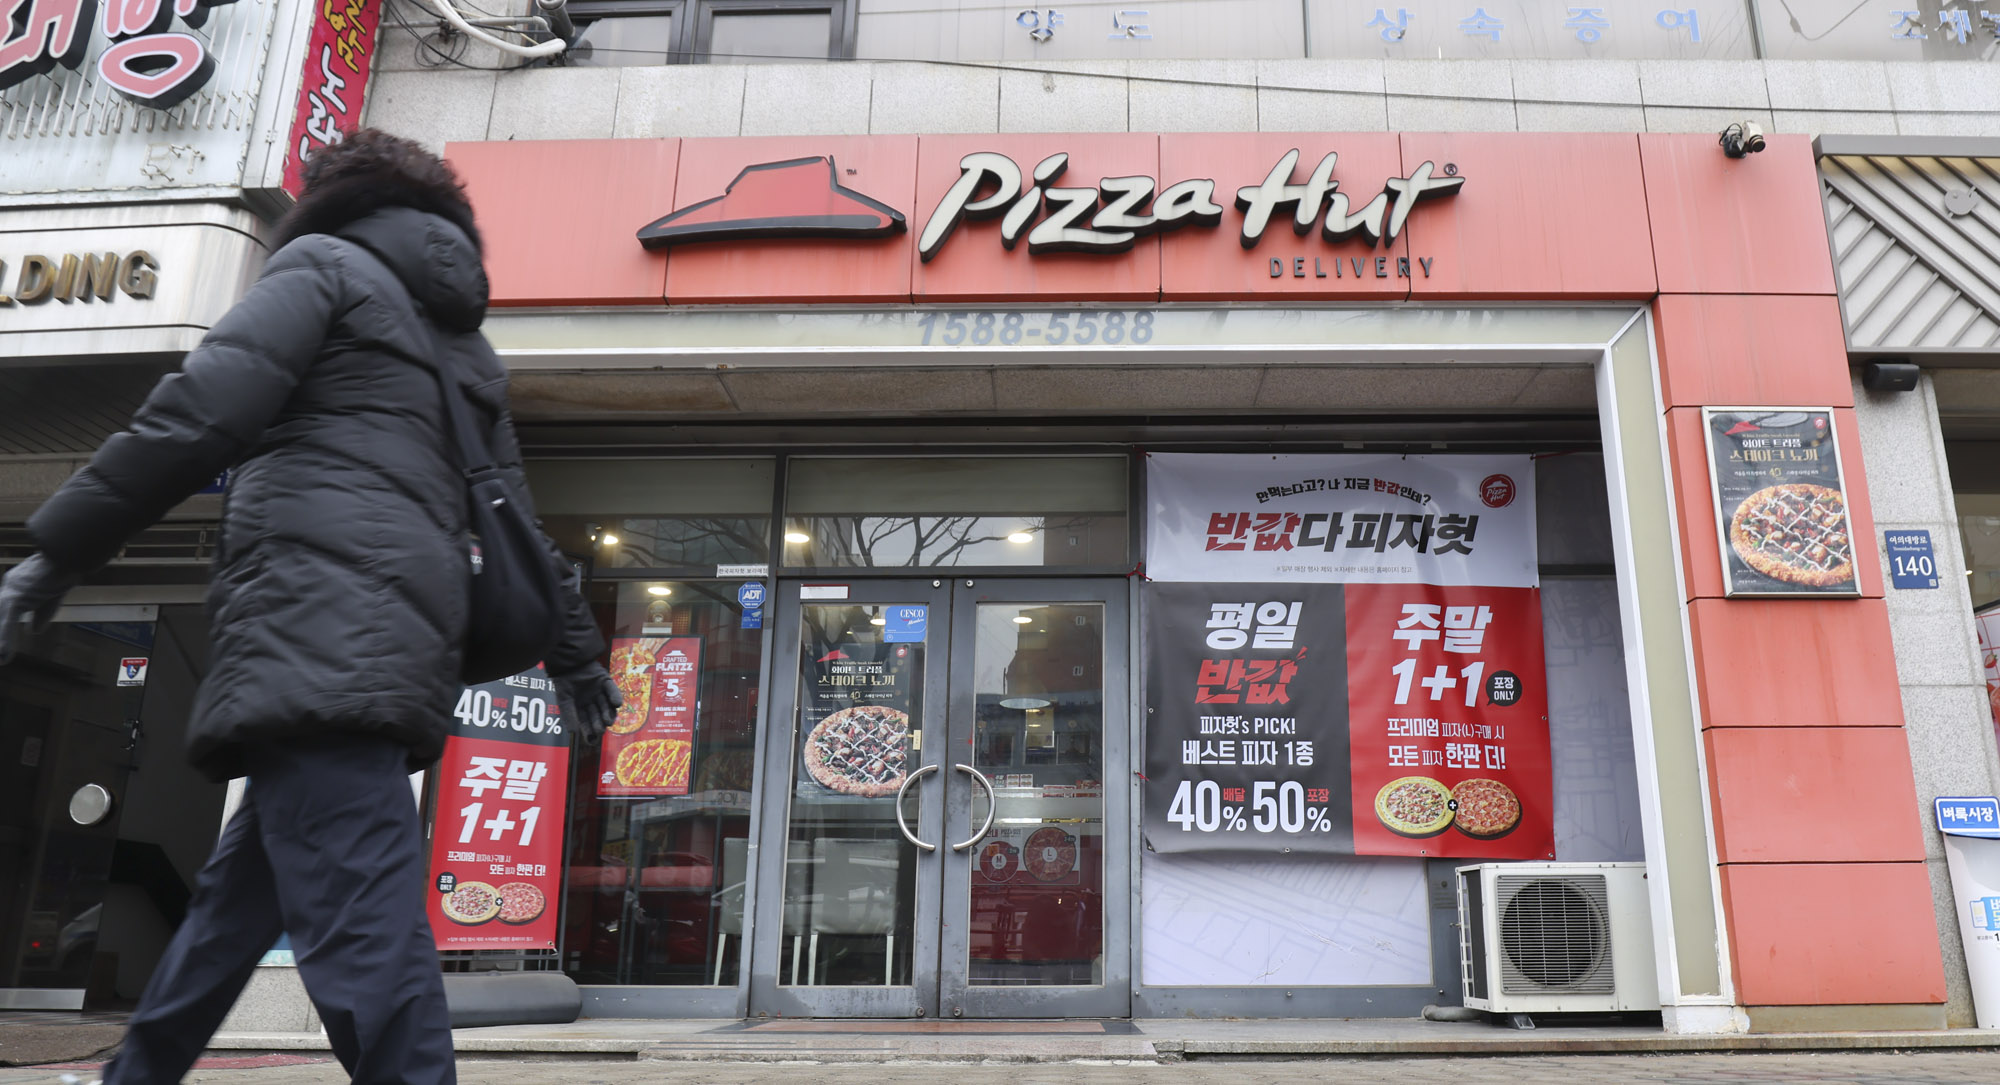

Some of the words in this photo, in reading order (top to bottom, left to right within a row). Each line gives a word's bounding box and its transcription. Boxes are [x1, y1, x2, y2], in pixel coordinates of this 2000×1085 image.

[918, 151, 1223, 264] Pizza
[1234, 148, 1466, 250] Hut
[1270, 256, 1434, 279] DELIVERY
[917, 311, 1156, 347] 1588-5588
[1742, 438, 1772, 448] 화이트
[1773, 438, 1802, 448] 트러플
[1729, 449, 1787, 463] 스테이크
[1789, 448, 1819, 462] 뇨끼
[1256, 478, 1325, 504] 안먹는다고?
[1328, 478, 1340, 490] 나
[1343, 477, 1370, 491] 지금
[1373, 477, 1432, 507] 반값인데?
[1345, 512, 1479, 556] 피자헛
[1889, 535, 1928, 545] 여의대방로
[1894, 555, 1933, 577] 140
[743, 590, 762, 600] ADT
[900, 608, 925, 618] CESCO
[1204, 601, 1304, 650] 평일
[1391, 602, 1494, 654] 주말
[655, 662, 694, 672] FLATZZ
[831, 665, 857, 675] 화이트
[858, 665, 883, 675] 트러플
[1194, 648, 1306, 705] 반값
[530, 677, 546, 691] 피자
[665, 678, 680, 697] 5
[818, 674, 867, 687] 스테이크
[870, 674, 896, 687] 뇨끼
[1391, 657, 1486, 708] 1+1
[1493, 676, 1515, 690] 포장
[1493, 690, 1515, 701] ONLY
[453, 688, 508, 729] 40%
[511, 694, 562, 735] 50%
[1199, 715, 1249, 735] 피자헛's
[1254, 716, 1297, 735] PICK!
[1387, 717, 1439, 738] 프리미엄
[1493, 725, 1505, 740] 시
[1182, 740, 1237, 766] 베스트
[1241, 740, 1279, 766] 피자
[1284, 740, 1315, 767] 1종
[1388, 745, 1419, 767] 모든
[1421, 749, 1443, 767] 피자
[1445, 742, 1482, 769] 한판
[1485, 745, 1507, 771] 더!
[459, 756, 548, 801] 주말
[1223, 787, 1246, 802] 배달
[1306, 788, 1330, 803] 포장
[1166, 779, 1248, 832] 40%
[1252, 780, 1332, 834] 50%
[1942, 806, 1994, 822] 벼룩시장
[458, 802, 542, 846] 1+1
[447, 850, 476, 862] 프리미엄
[440, 875, 454, 884] 포장
[489, 864, 505, 875] 모든
[516, 863, 534, 876] 한판
